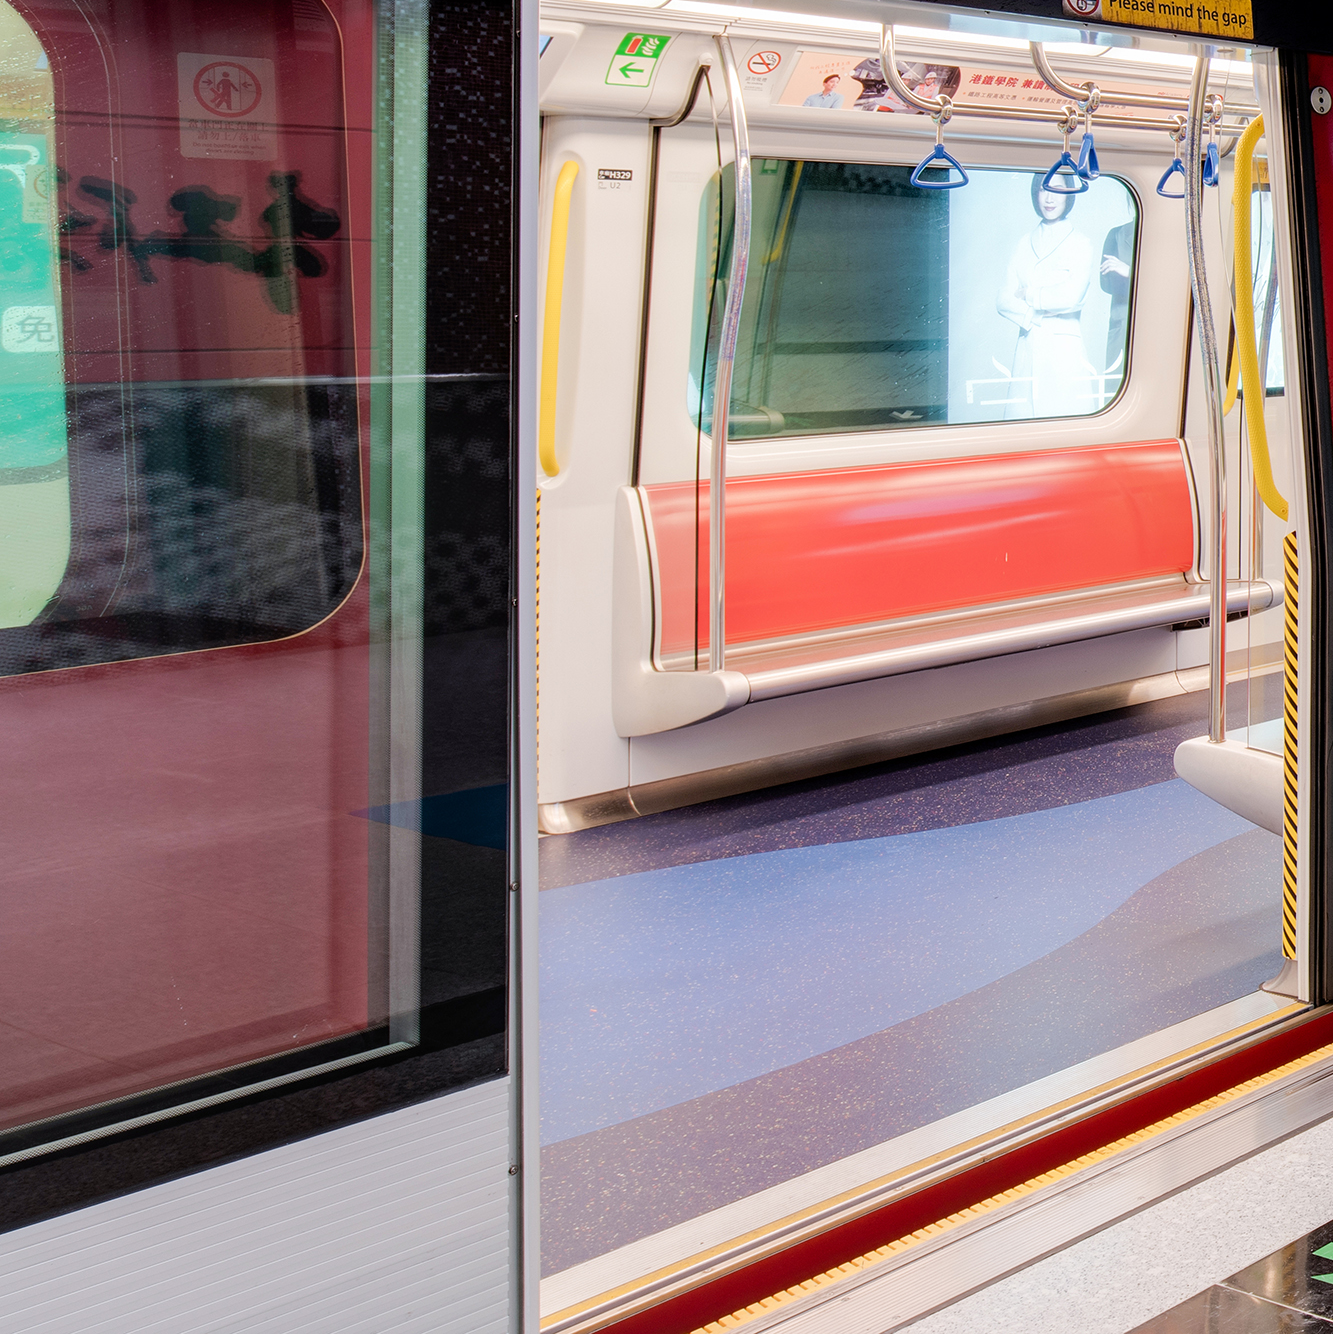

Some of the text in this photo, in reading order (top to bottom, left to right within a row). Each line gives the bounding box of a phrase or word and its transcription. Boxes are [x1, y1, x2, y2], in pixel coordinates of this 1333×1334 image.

[1158, 1, 1193, 18] mind
[1197, 6, 1218, 22] the
[1222, 11, 1246, 28] gap
[610, 171, 631, 179] H329
